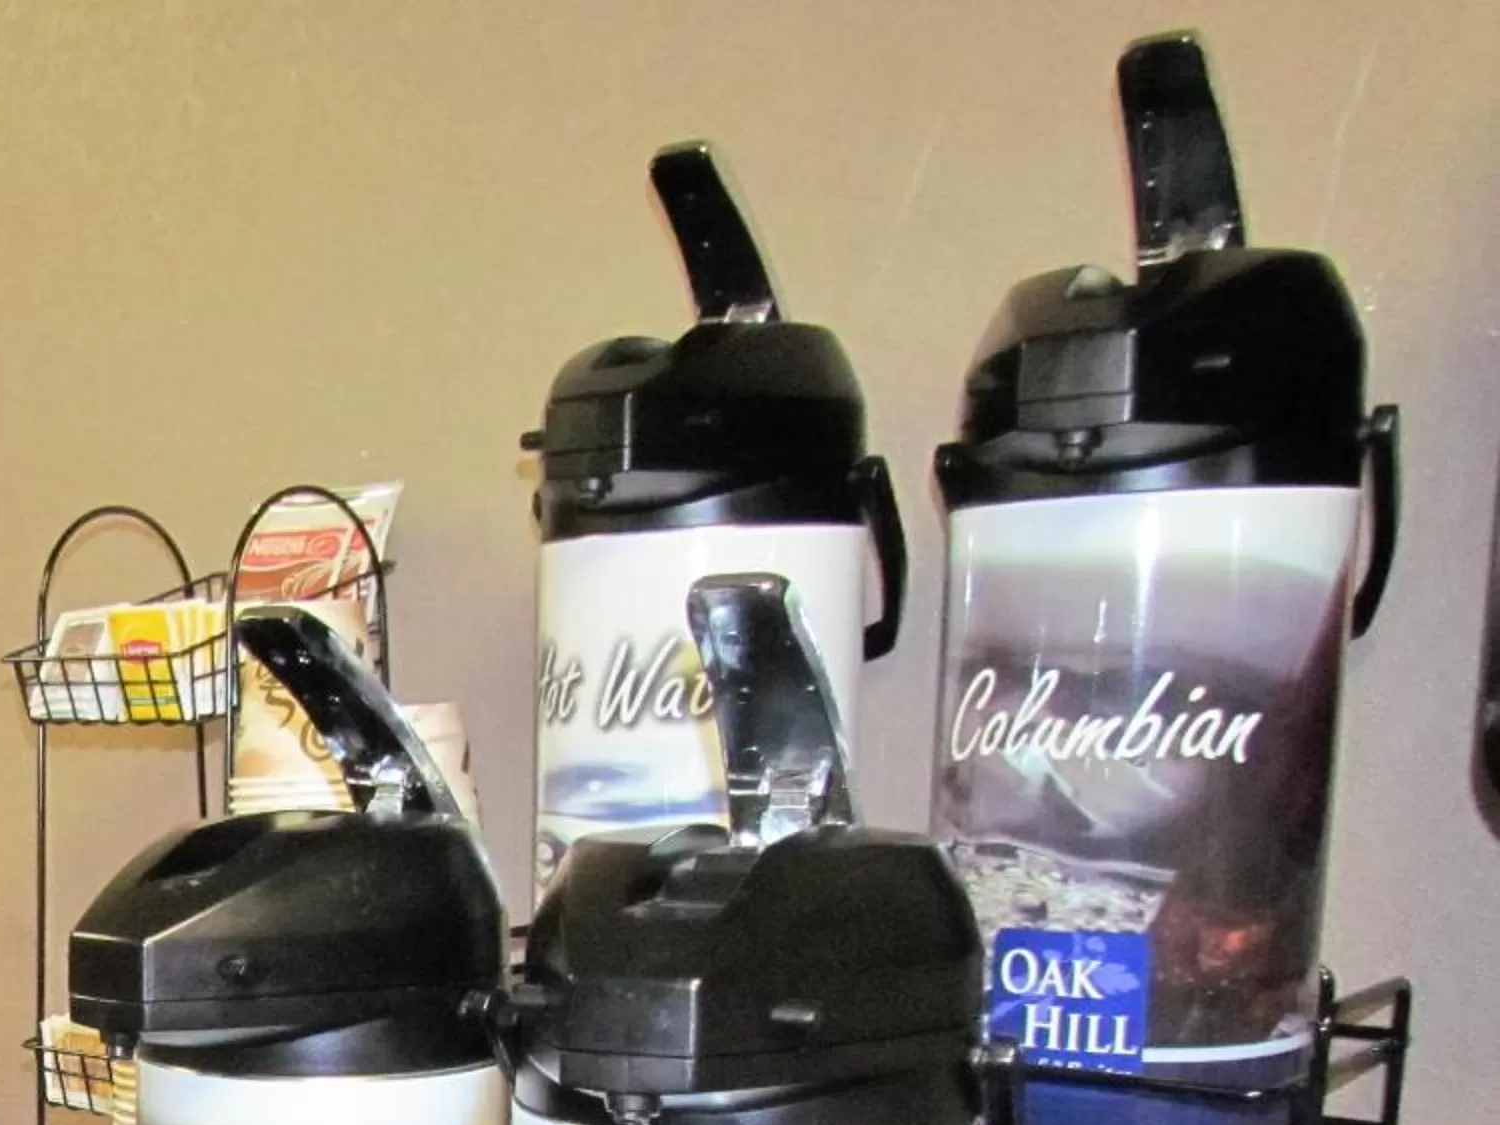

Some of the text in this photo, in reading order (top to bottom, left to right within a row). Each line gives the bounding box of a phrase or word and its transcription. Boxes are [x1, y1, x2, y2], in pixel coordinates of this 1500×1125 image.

[951, 668, 1263, 763] Columbian
[1001, 947, 1105, 1000] OAK
[1020, 1002, 1140, 1056] HILL
